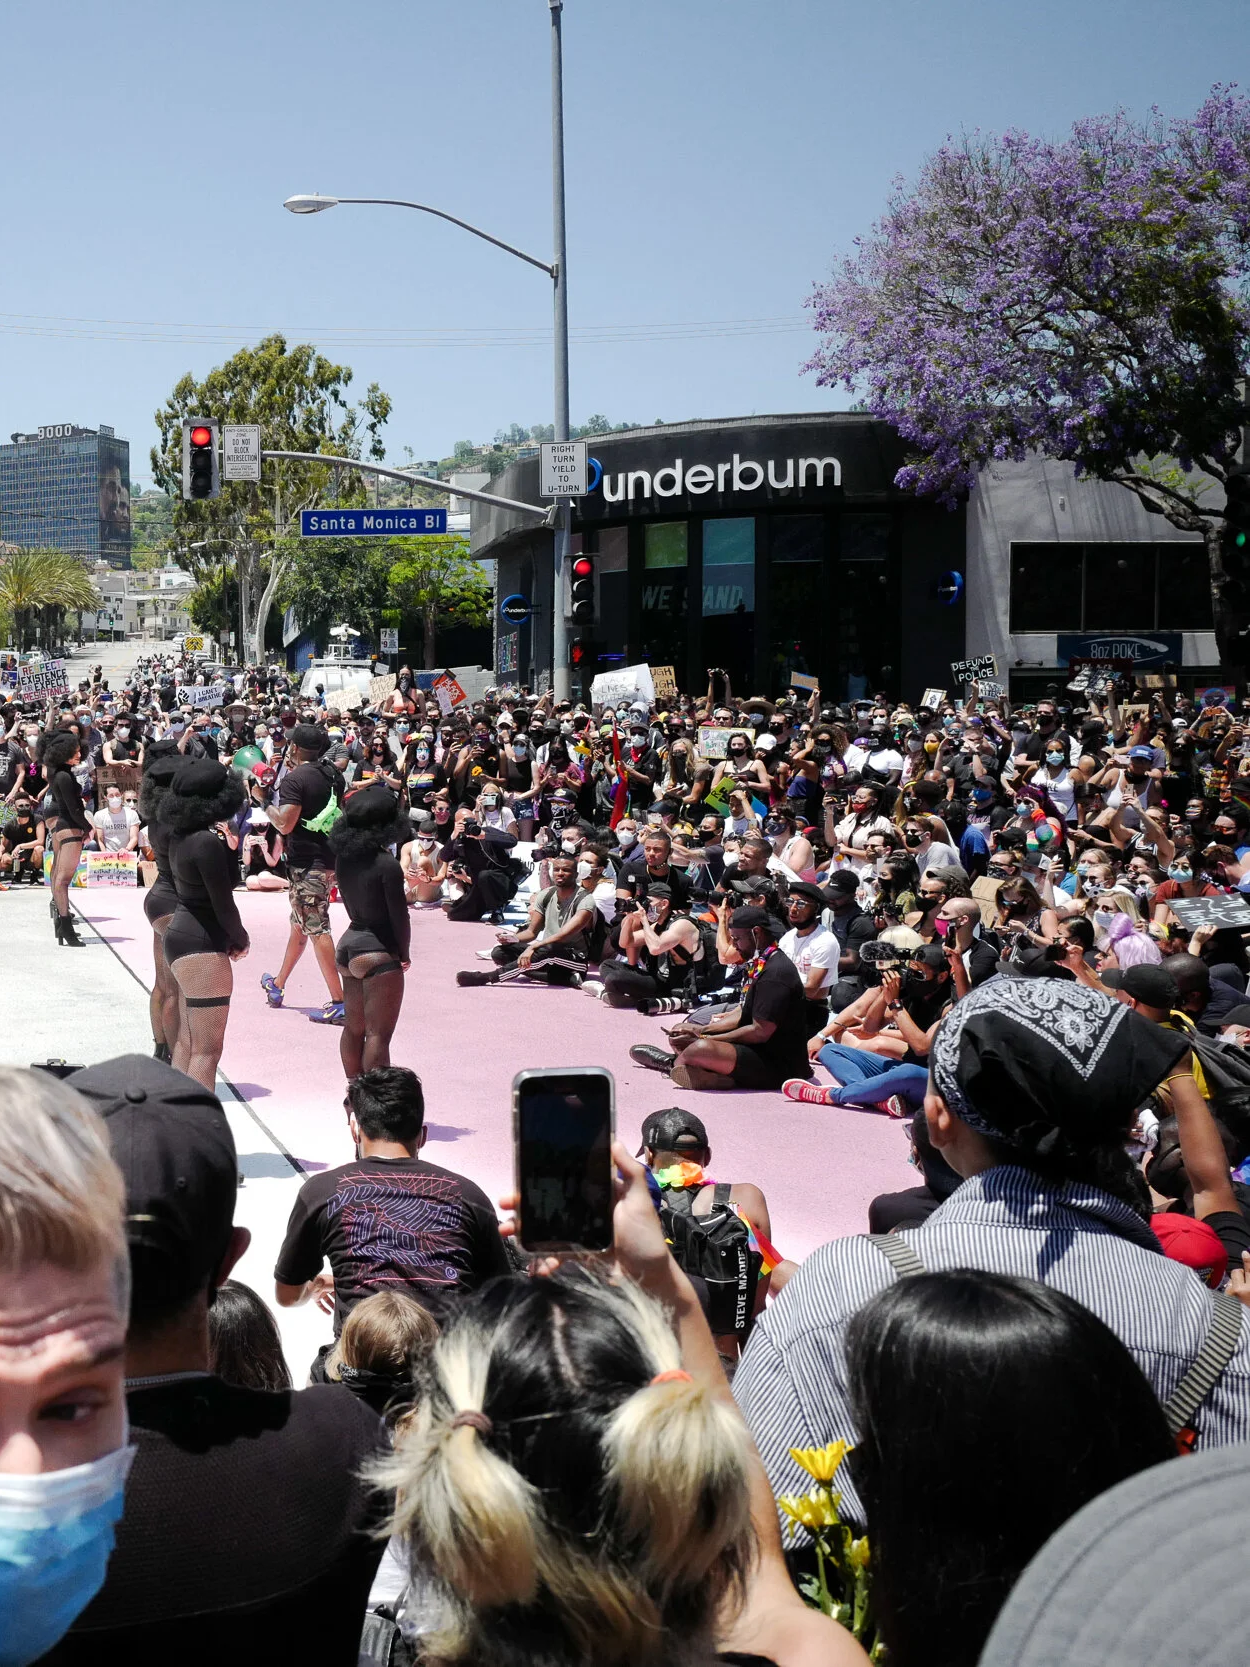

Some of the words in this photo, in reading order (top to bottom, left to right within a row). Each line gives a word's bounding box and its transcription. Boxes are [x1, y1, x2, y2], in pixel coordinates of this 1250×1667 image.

[37, 424, 71, 440] 9000
[588, 455, 842, 502] underbum
[548, 485, 580, 493] U-TURN
[309, 516, 355, 529] Santa
[363, 515, 417, 529] Monica
[425, 514, 440, 528] Bl
[1112, 643, 1141, 659] POKE
[22, 659, 61, 675] RESPECT
[951, 655, 994, 671] DEFUND
[21, 668, 67, 685] EXISTENCE
[958, 668, 994, 682] POLICE
[34, 678, 67, 691] EXPECT
[201, 687, 218, 695] CAN'T
[372, 683, 396, 693] LIVES
[601, 683, 629, 693] LIVES
[22, 687, 70, 701] RESISTANCE
[198, 692, 221, 702] BREATHE
[327, 1184, 462, 1232] MOTIVATED
[351, 1209, 374, 1244] TO
[377, 1222, 417, 1253] DO
[735, 1293, 747, 1329] STEVE
